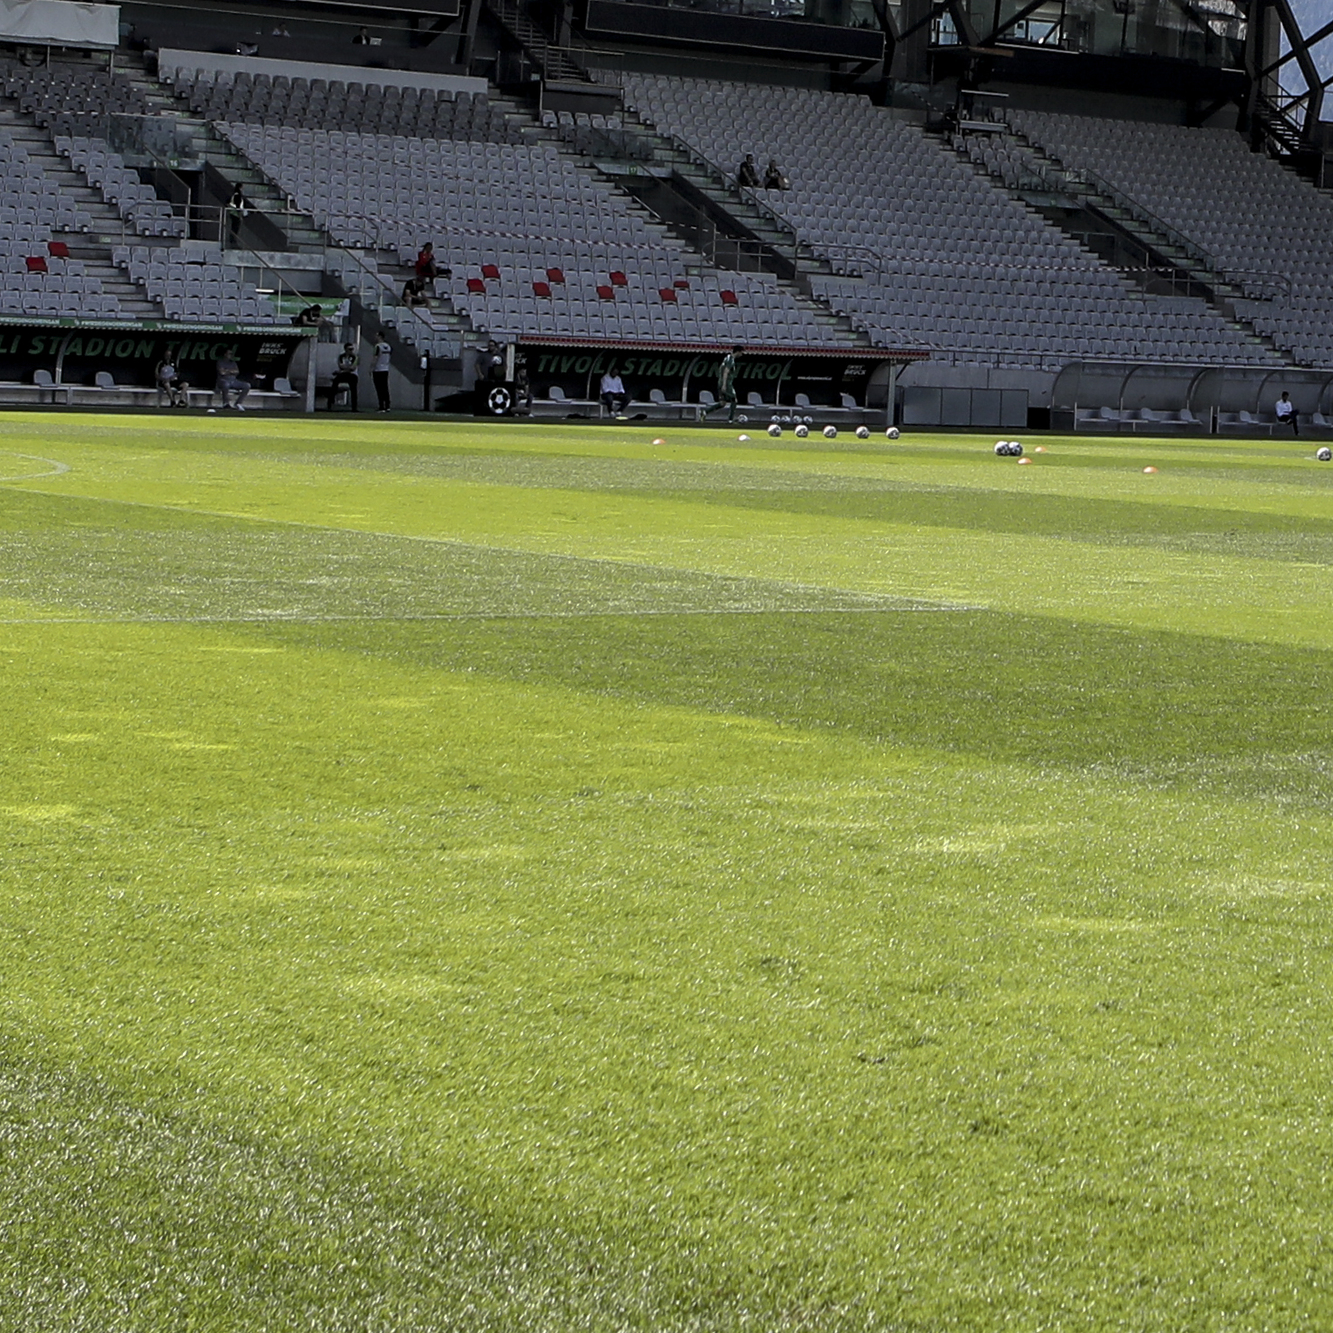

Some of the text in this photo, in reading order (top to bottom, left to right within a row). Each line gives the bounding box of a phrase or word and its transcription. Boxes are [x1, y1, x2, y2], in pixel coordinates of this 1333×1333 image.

[27, 335, 157, 359] STADION
[537, 354, 618, 375] TIVOLI
[734, 362, 792, 381] TIROL
